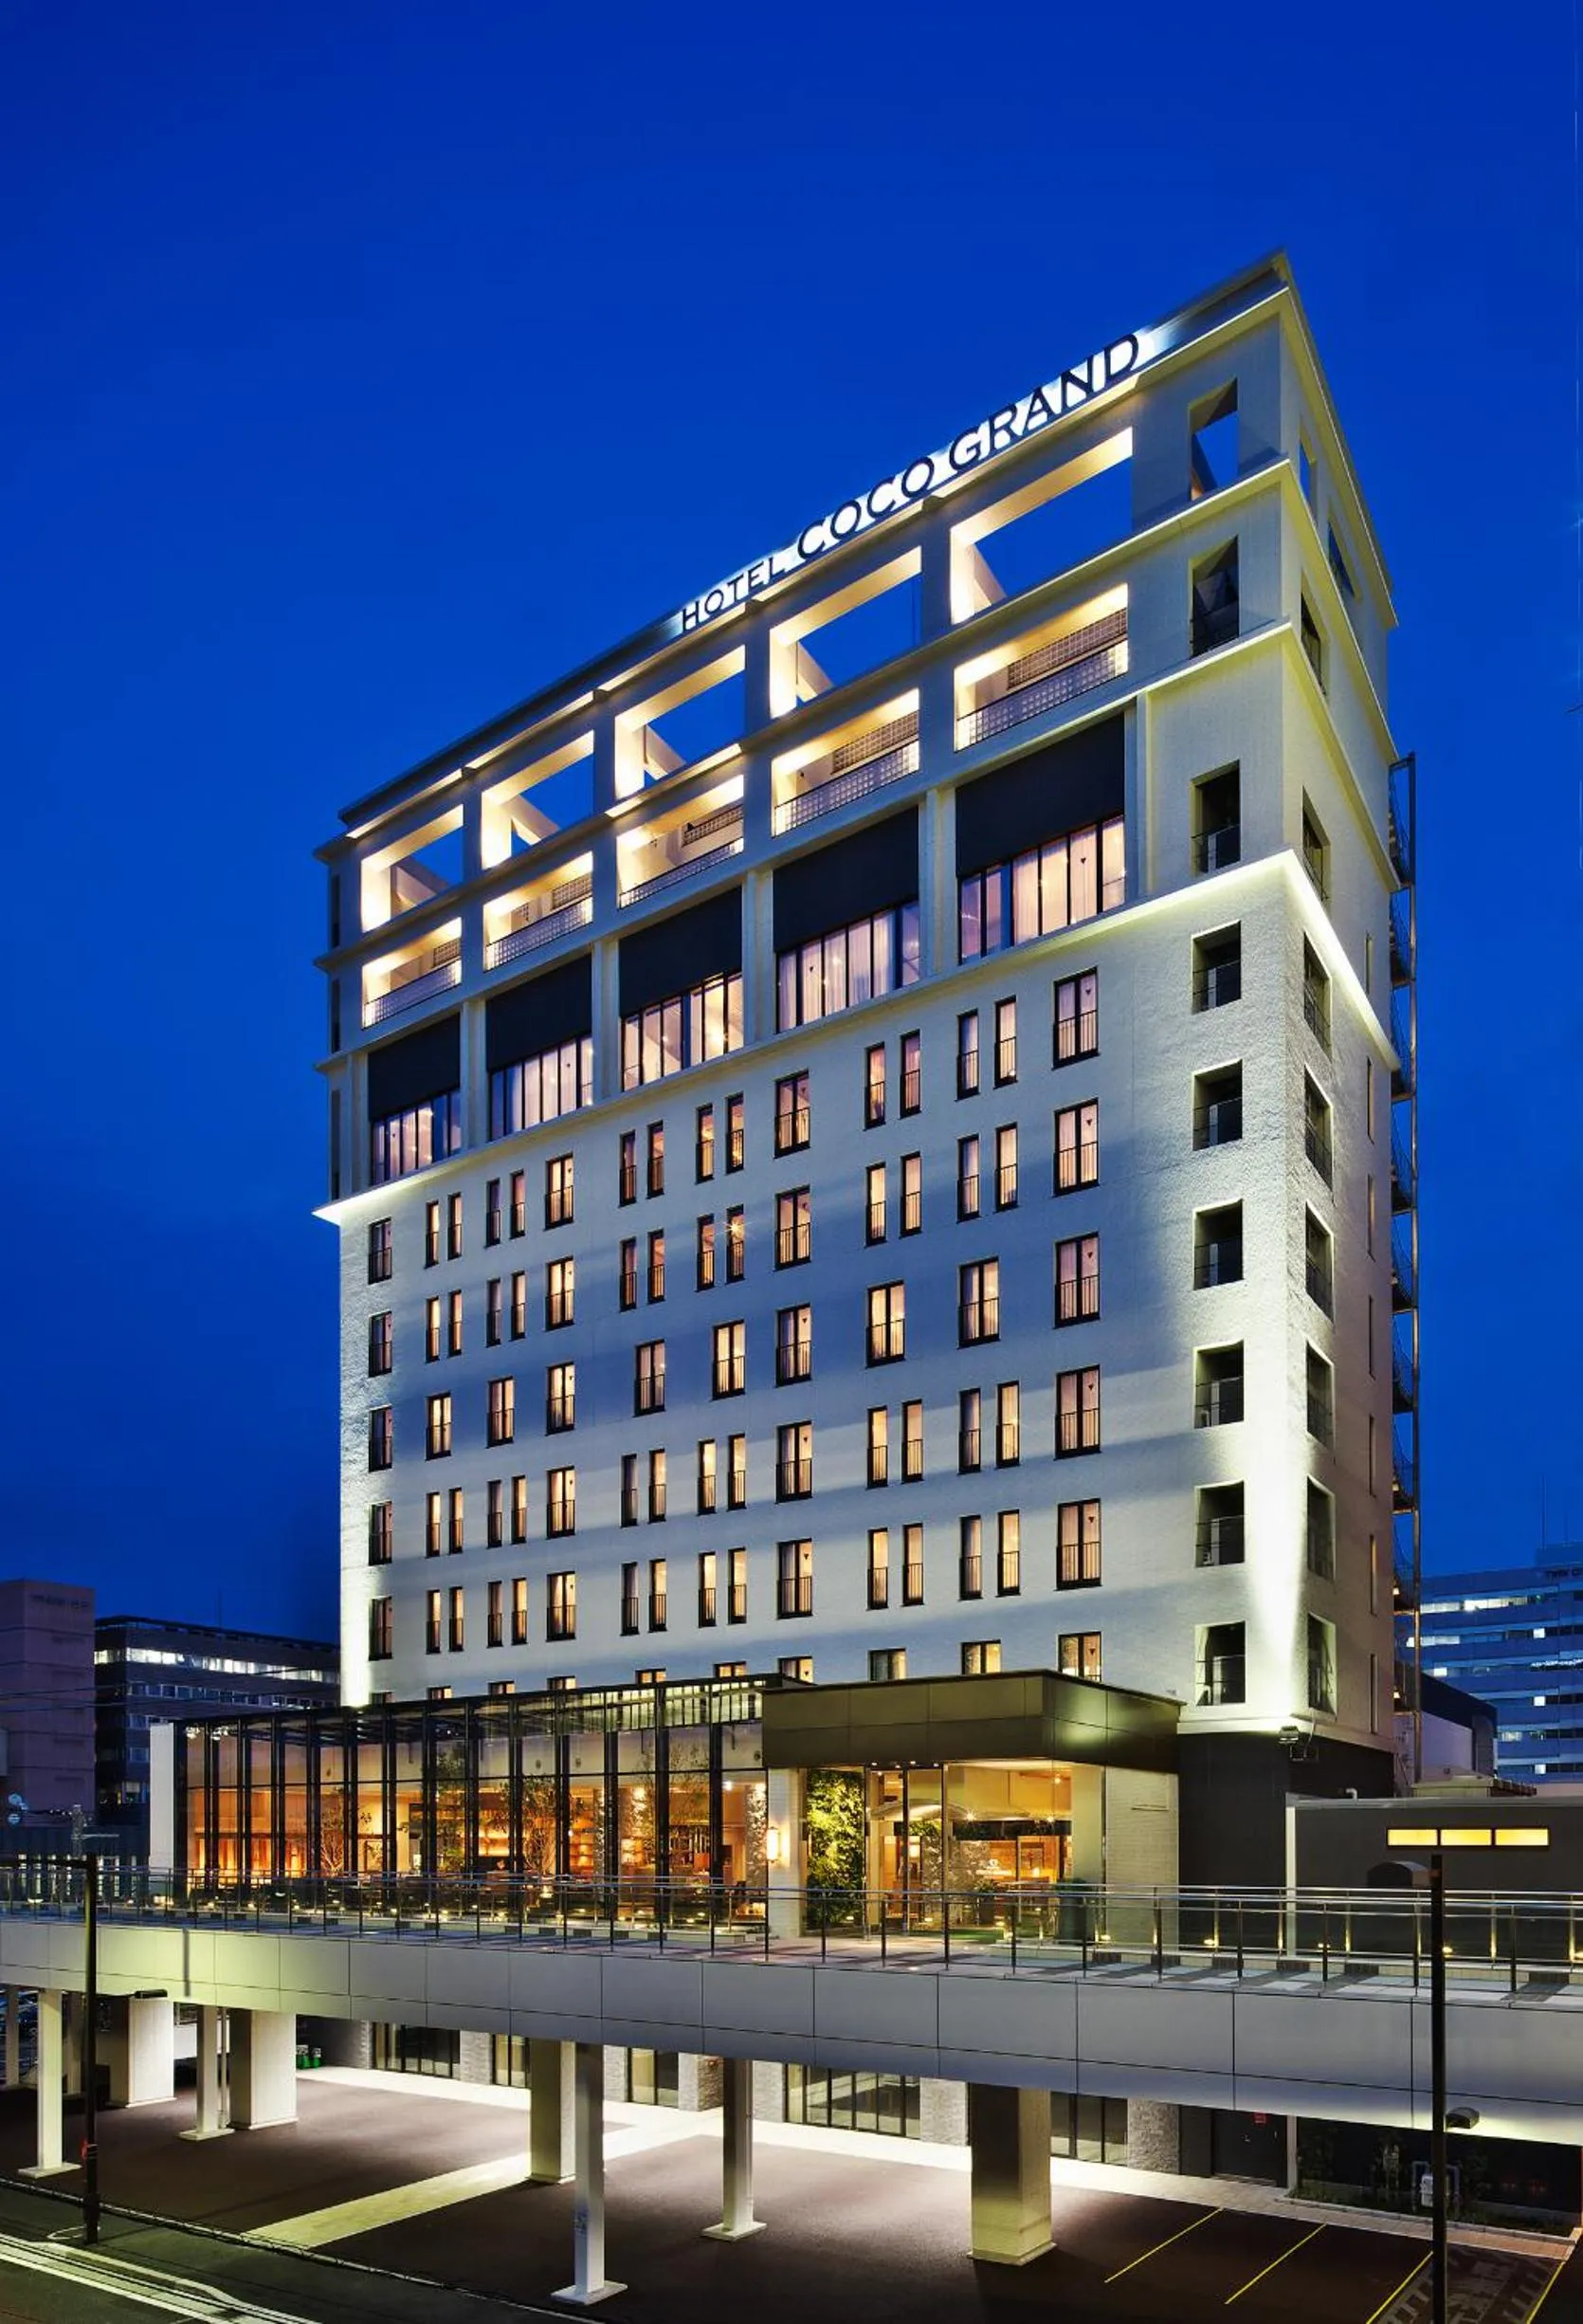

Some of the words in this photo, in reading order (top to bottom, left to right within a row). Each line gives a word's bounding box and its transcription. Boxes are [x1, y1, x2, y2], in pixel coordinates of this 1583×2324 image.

[682, 556, 786, 631] HOTEL
[797, 456, 935, 559] COCO
[949, 334, 1139, 471] GRAND
